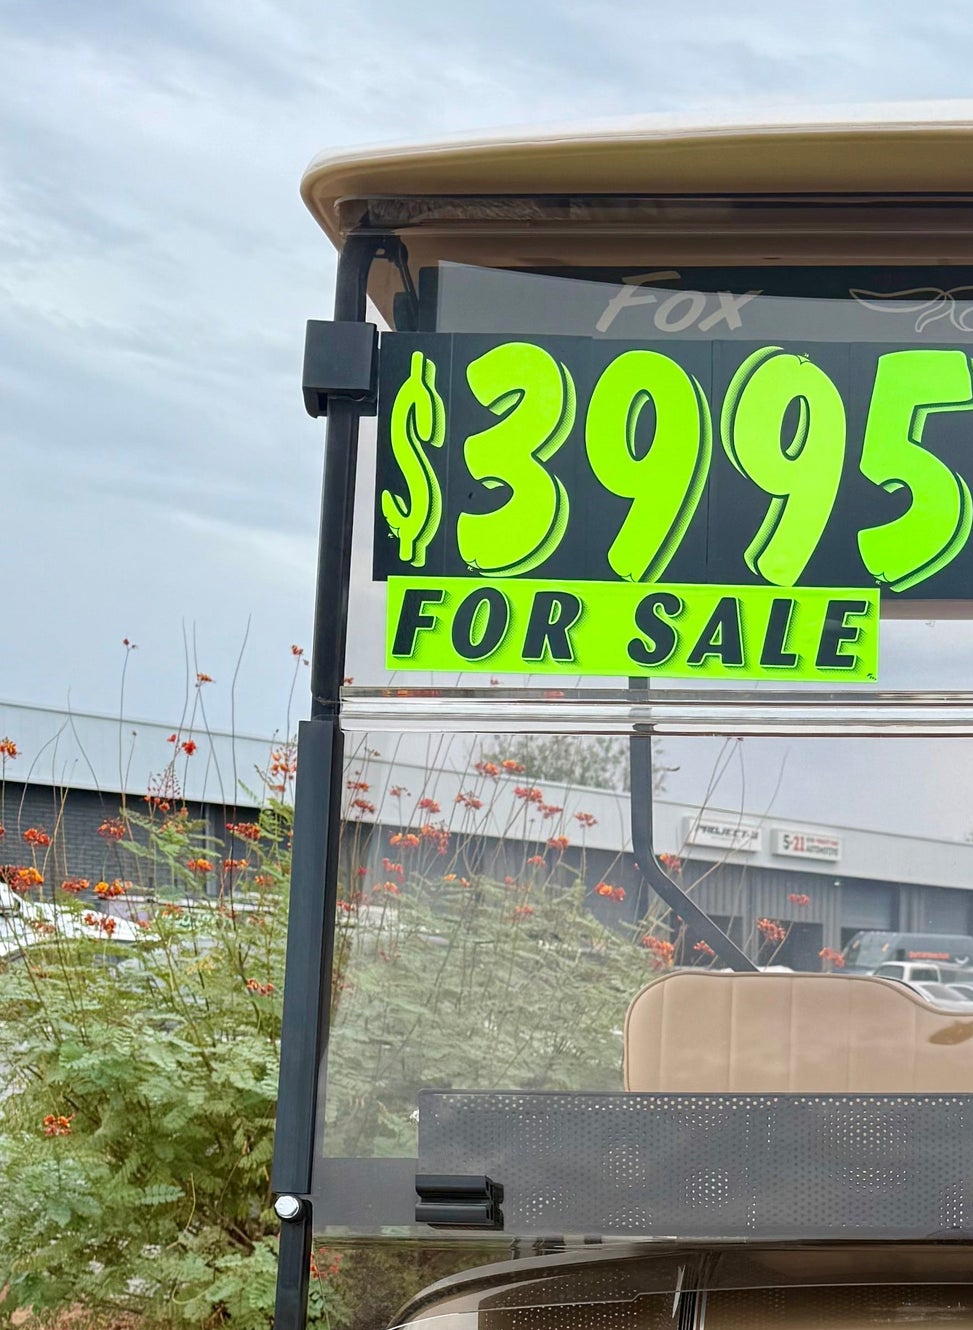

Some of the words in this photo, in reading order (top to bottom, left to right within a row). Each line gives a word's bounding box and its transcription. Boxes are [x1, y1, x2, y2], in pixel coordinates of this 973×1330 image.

[595, 270, 764, 333] Fox
[391, 586, 585, 662] FOR
[627, 591, 871, 670] SALE
